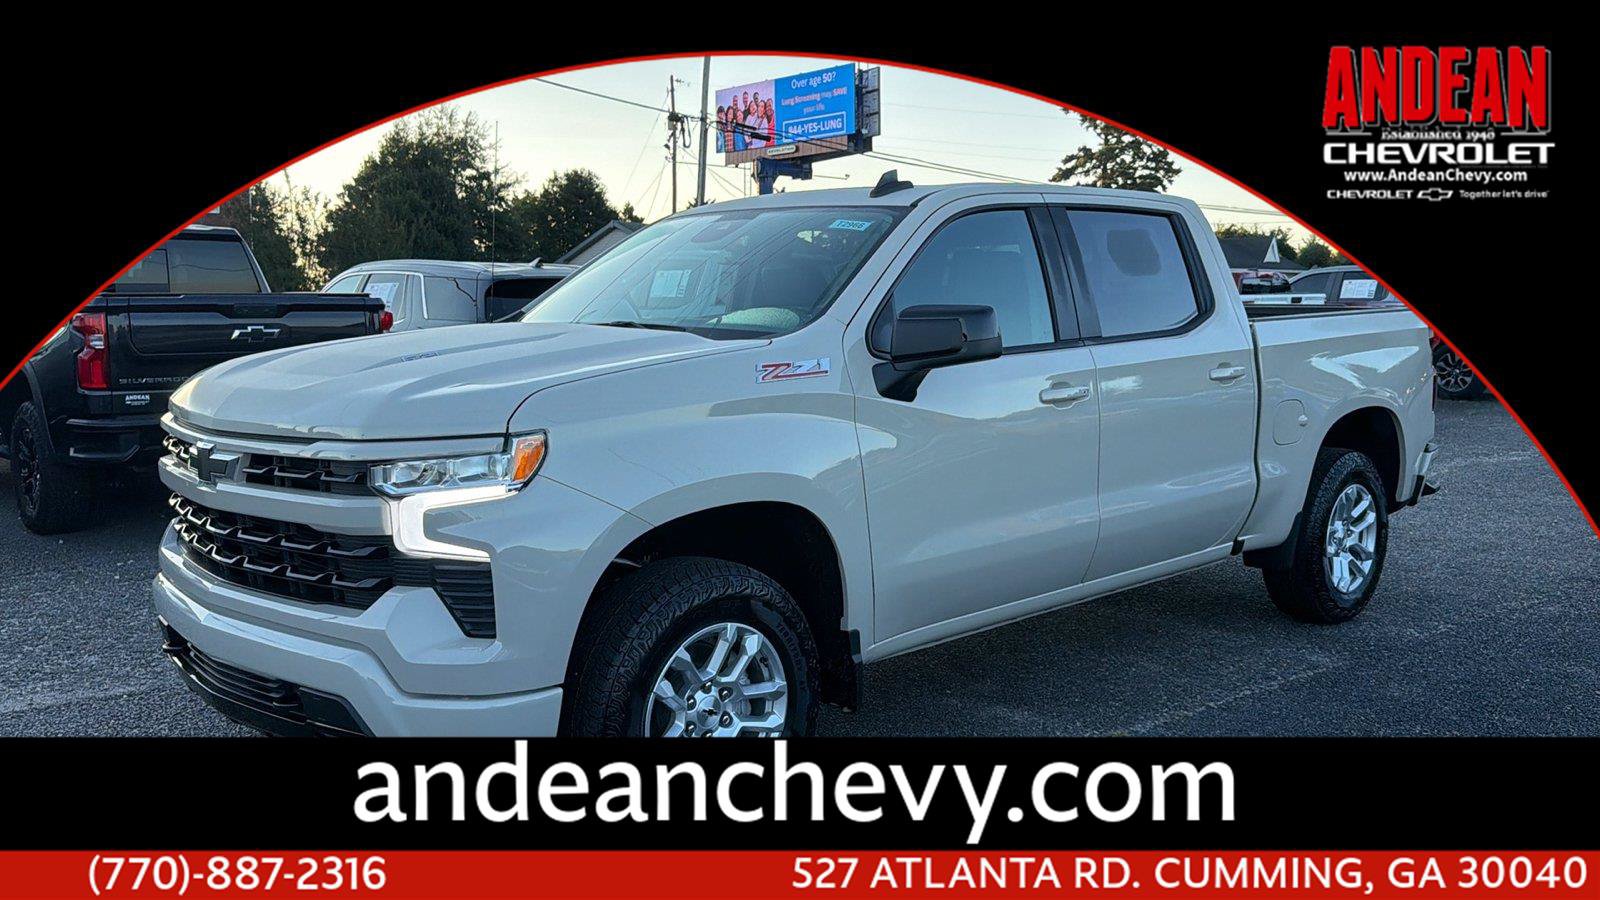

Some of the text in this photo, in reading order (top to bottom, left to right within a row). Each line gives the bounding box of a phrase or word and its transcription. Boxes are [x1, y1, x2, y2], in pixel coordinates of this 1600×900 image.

[790, 71, 837, 89] Over age 50?
